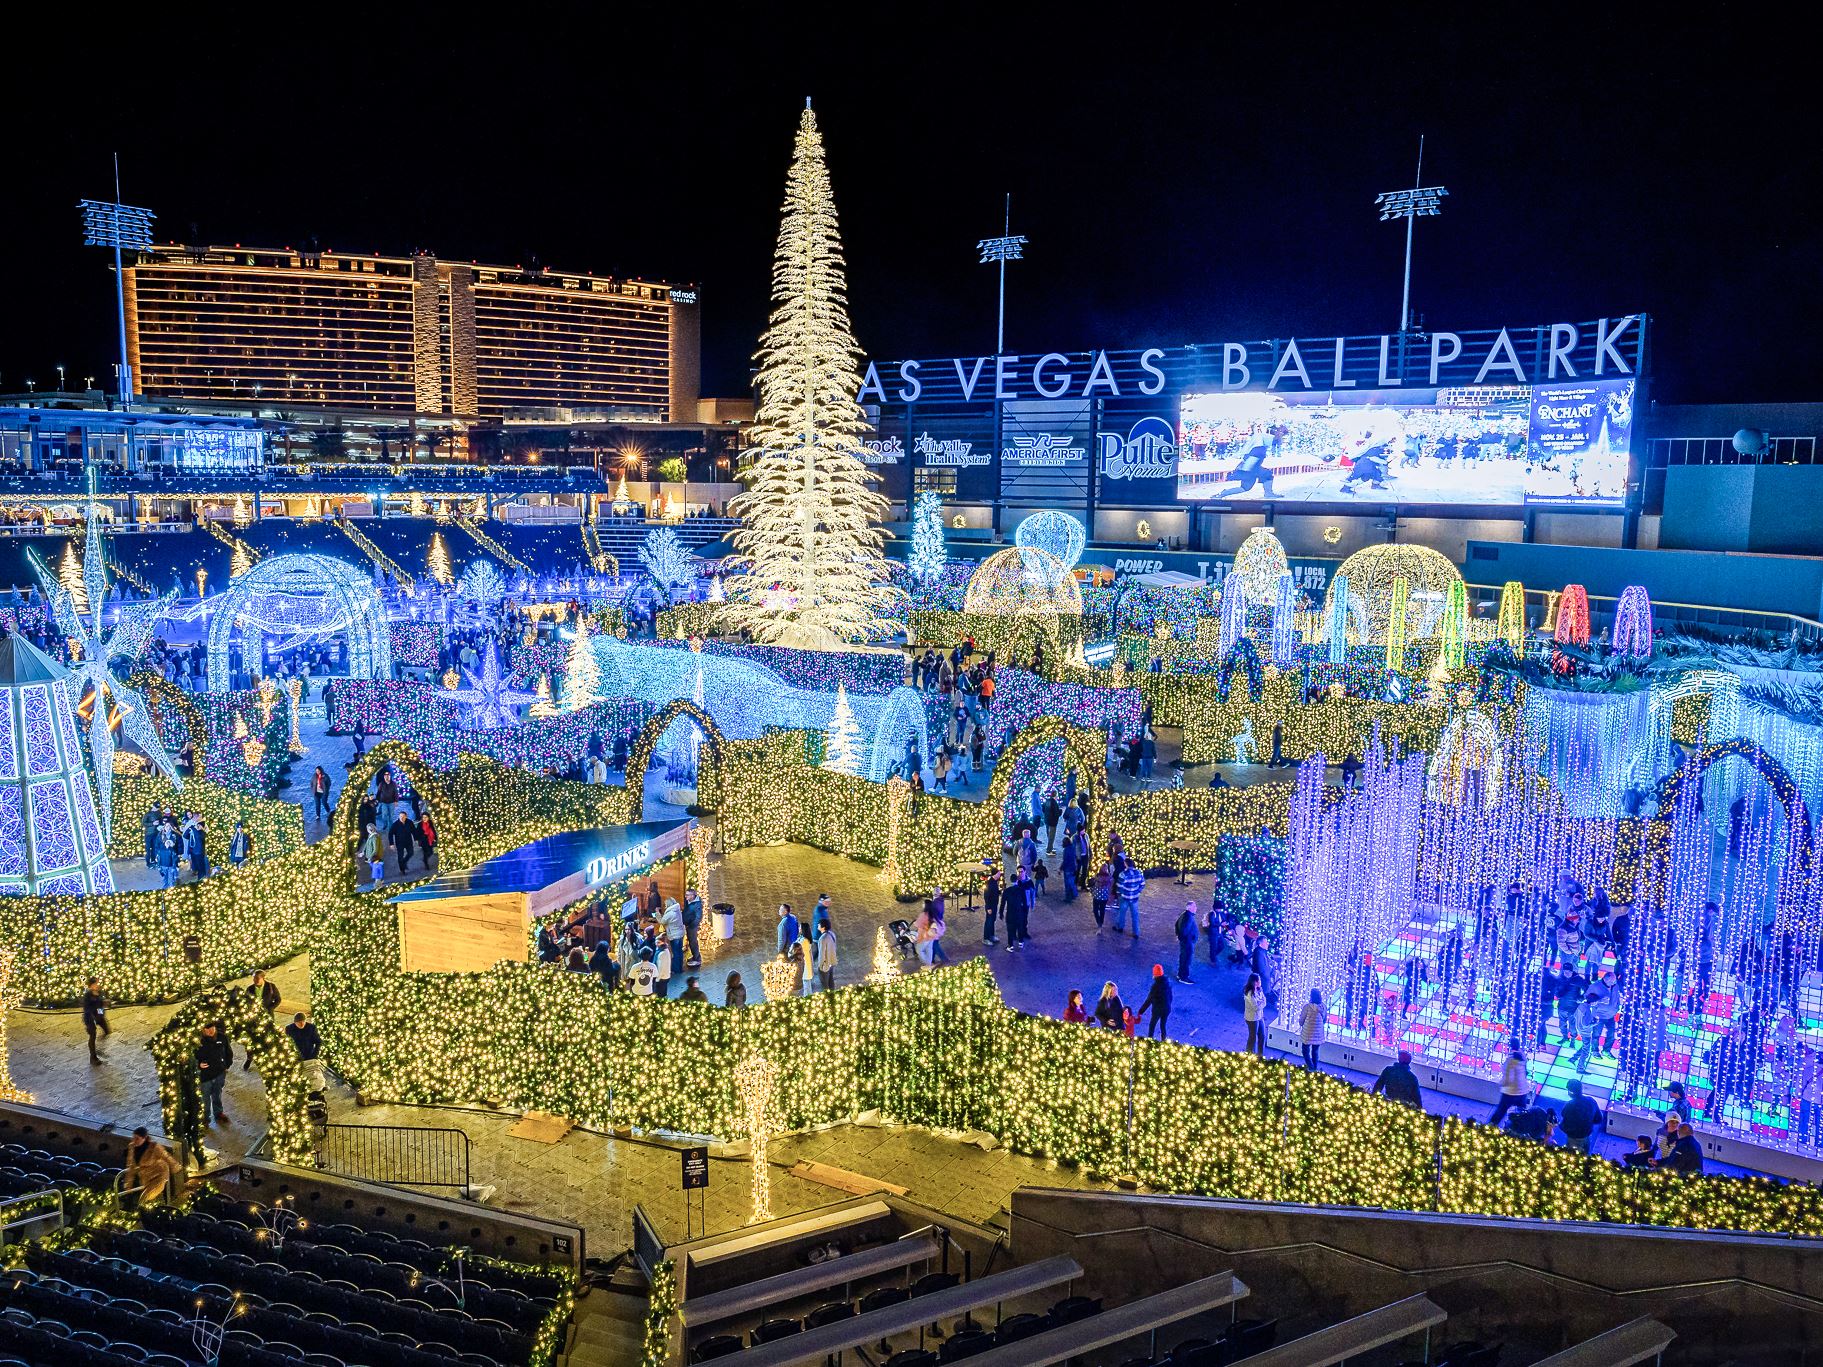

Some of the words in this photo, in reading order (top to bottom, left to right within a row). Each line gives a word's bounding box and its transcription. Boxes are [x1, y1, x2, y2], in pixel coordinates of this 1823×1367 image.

[682, 292, 696, 300] rock
[953, 349, 1165, 402] VEGAS
[1222, 317, 1634, 391] BALLPARK
[1538, 404, 1596, 421] ENCHANT
[926, 440, 942, 452] The
[941, 440, 971, 454] Valley
[1001, 449, 1049, 459] AMERICA
[1051, 449, 1084, 459] FIRST
[1100, 434, 1173, 471] Pulte
[926, 453, 958, 464] Health
[959, 454, 990, 467] System
[1112, 460, 1173, 479] Homes
[1115, 559, 1163, 574] POWER
[1304, 567, 1326, 576] LOCAL
[1304, 576, 1326, 590] 872
[587, 840, 649, 884] DRINKS
[556, 1238, 567, 1247] 102
